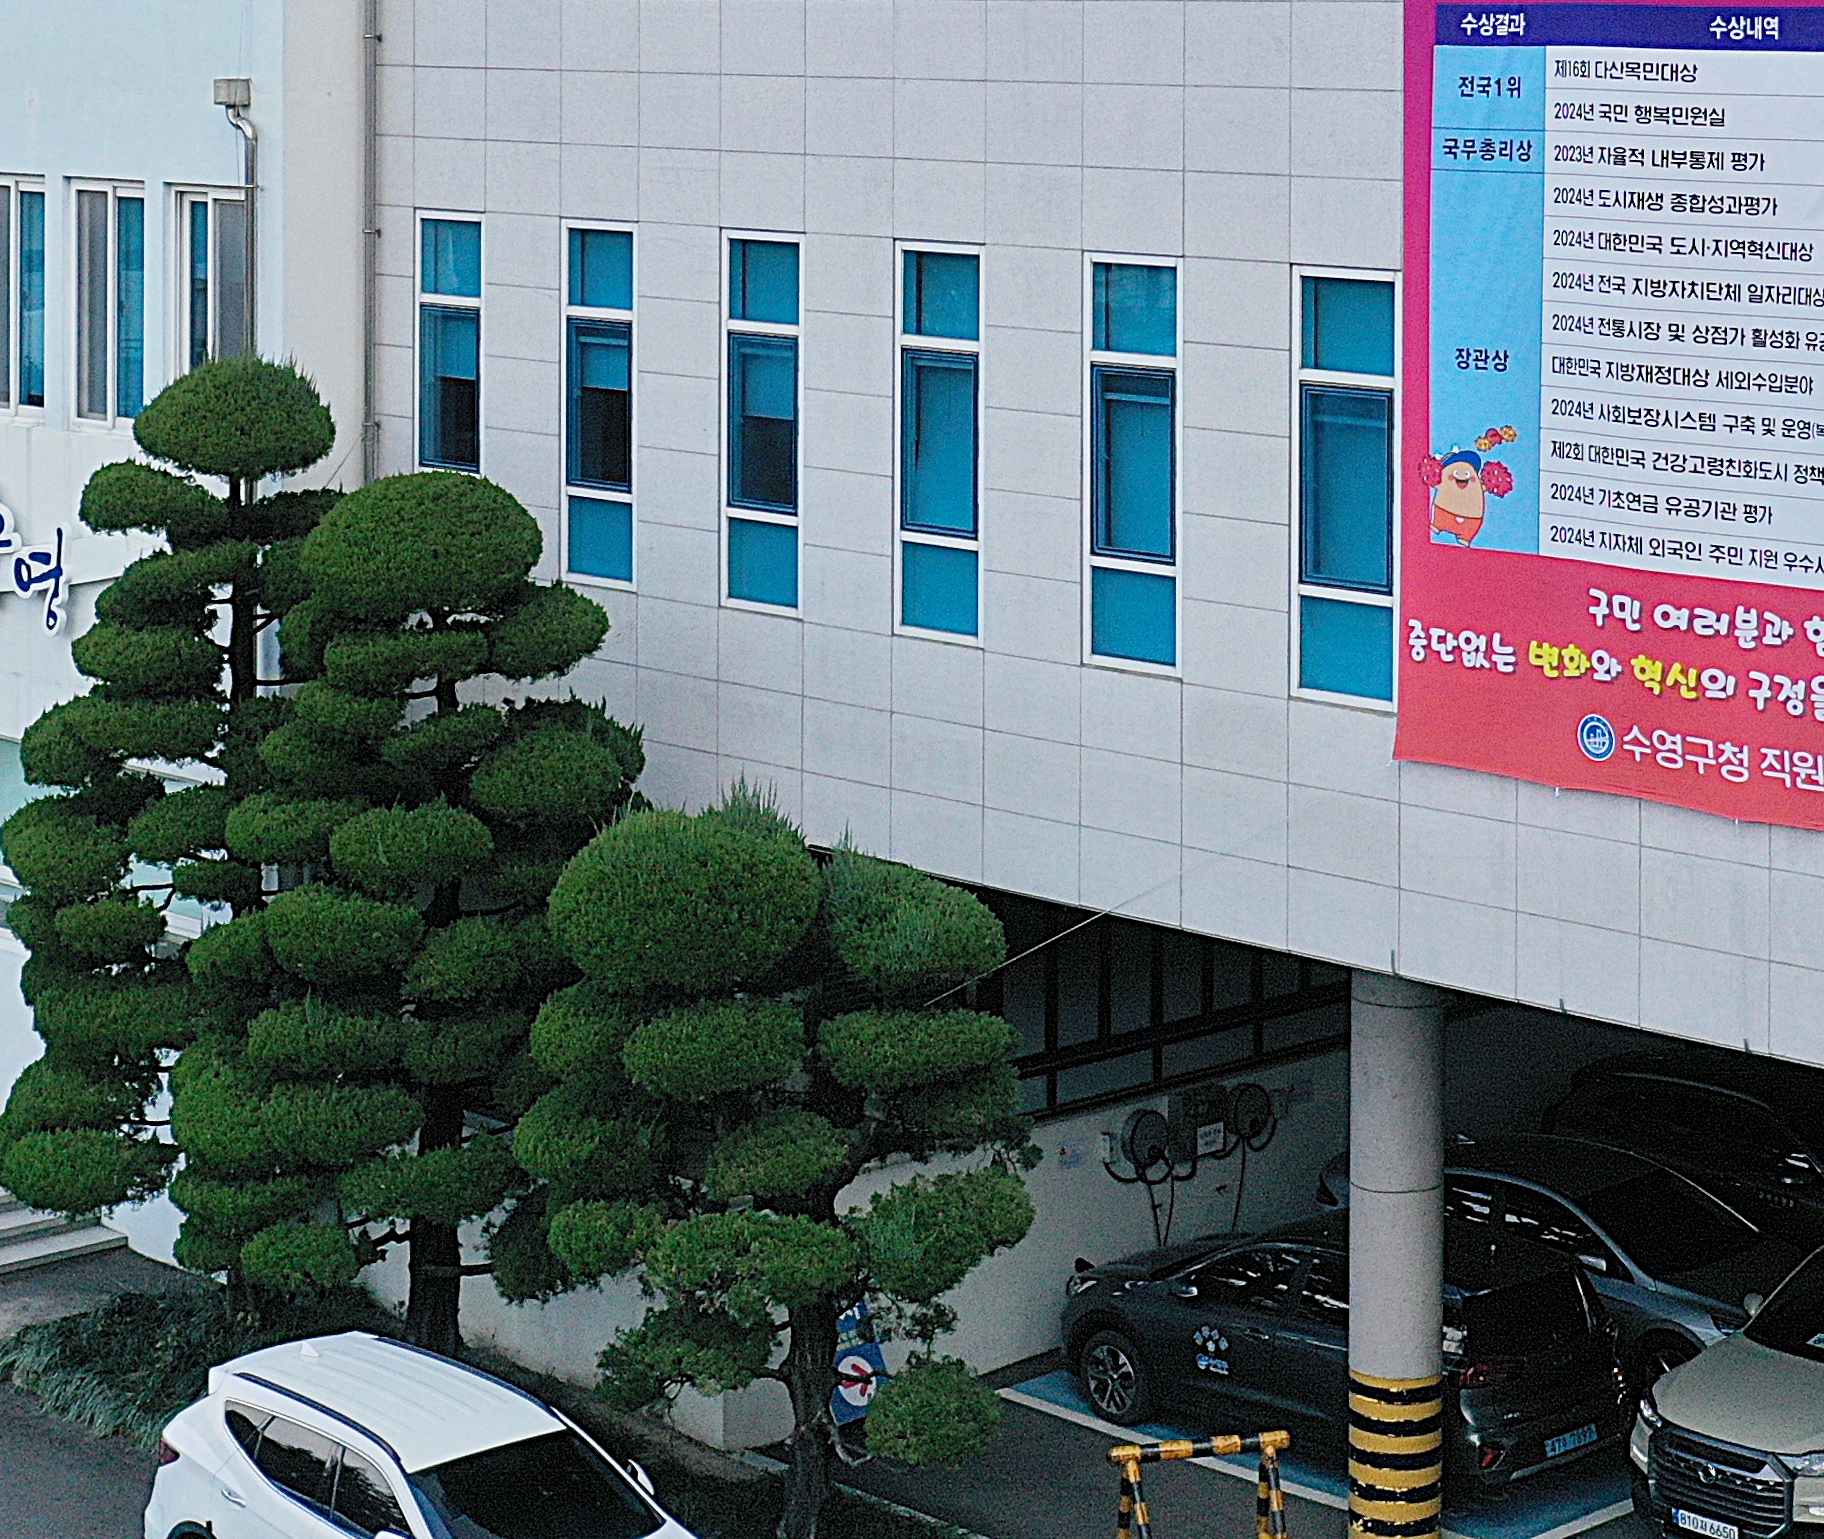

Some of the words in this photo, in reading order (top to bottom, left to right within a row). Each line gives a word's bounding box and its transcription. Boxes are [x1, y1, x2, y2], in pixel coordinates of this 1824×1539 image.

[1460, 12, 1527, 37] 수상결과
[1708, 16, 1780, 41] 수상내역
[1554, 59, 1591, 82] 제16회
[1595, 59, 1698, 83] 다산목민대상
[1457, 76, 1522, 100] 전국1위
[1554, 102, 1595, 123] 2024년
[1598, 103, 1628, 126] 국민
[1634, 102, 1726, 127] 행복민원실
[1442, 137, 1532, 162] 국무총리상
[1554, 145, 1594, 167] 2023년
[1597, 146, 1646, 169] 자율적
[1651, 149, 1725, 172] 내부통제
[1730, 150, 1765, 172] 평가
[1552, 186, 1595, 209] 2024년
[1598, 190, 1665, 213] 도시재생
[1670, 191, 1778, 219] 종합성과평가
[1552, 229, 1595, 252] 2024년
[1597, 231, 1664, 256] 대한민국
[1552, 272, 1594, 293] 2024년
[1597, 275, 1627, 296] 전국
[1632, 277, 1742, 303] 지방자치단체
[1552, 315, 1594, 336] 2024년
[1598, 317, 1662, 341] 전통시장
[1668, 322, 1686, 342] 및
[1692, 323, 1746, 349] 상점가
[1751, 327, 1800, 351] 활성화
[1454, 347, 1510, 371] 장관상
[1551, 356, 1601, 379] 대한민국
[1605, 360, 1710, 387] 지방재정대상
[1715, 366, 1814, 396] 세외수입분야
[1551, 399, 1595, 421] 2024년
[1598, 403, 1717, 431] 사회보장시스템
[1722, 411, 1756, 435] 구축
[1761, 415, 1777, 437] 및
[1550, 441, 1584, 461] 제2회
[1588, 445, 1646, 469] 대한민국
[1652, 450, 1787, 482] 건강고령친화도시
[1550, 483, 1595, 507] 2024년
[1598, 487, 1658, 513] 기초연금
[1665, 493, 1737, 521] 유공기관
[1743, 502, 1774, 525] 평가
[1550, 526, 1595, 550] 2024년
[1598, 531, 1644, 555] 지자체
[1648, 536, 1702, 562] 외국인
[1708, 542, 1742, 565] 주민
[1748, 545, 1777, 569] 지원
[1586, 587, 1641, 630] 구민
[1653, 602, 1792, 643] 여러분과
[1407, 620, 1515, 671] 중단없는
[1528, 641, 1621, 680] 변화와
[1631, 656, 1735, 697] 혁신의
[1621, 723, 1751, 782] 수영구청
